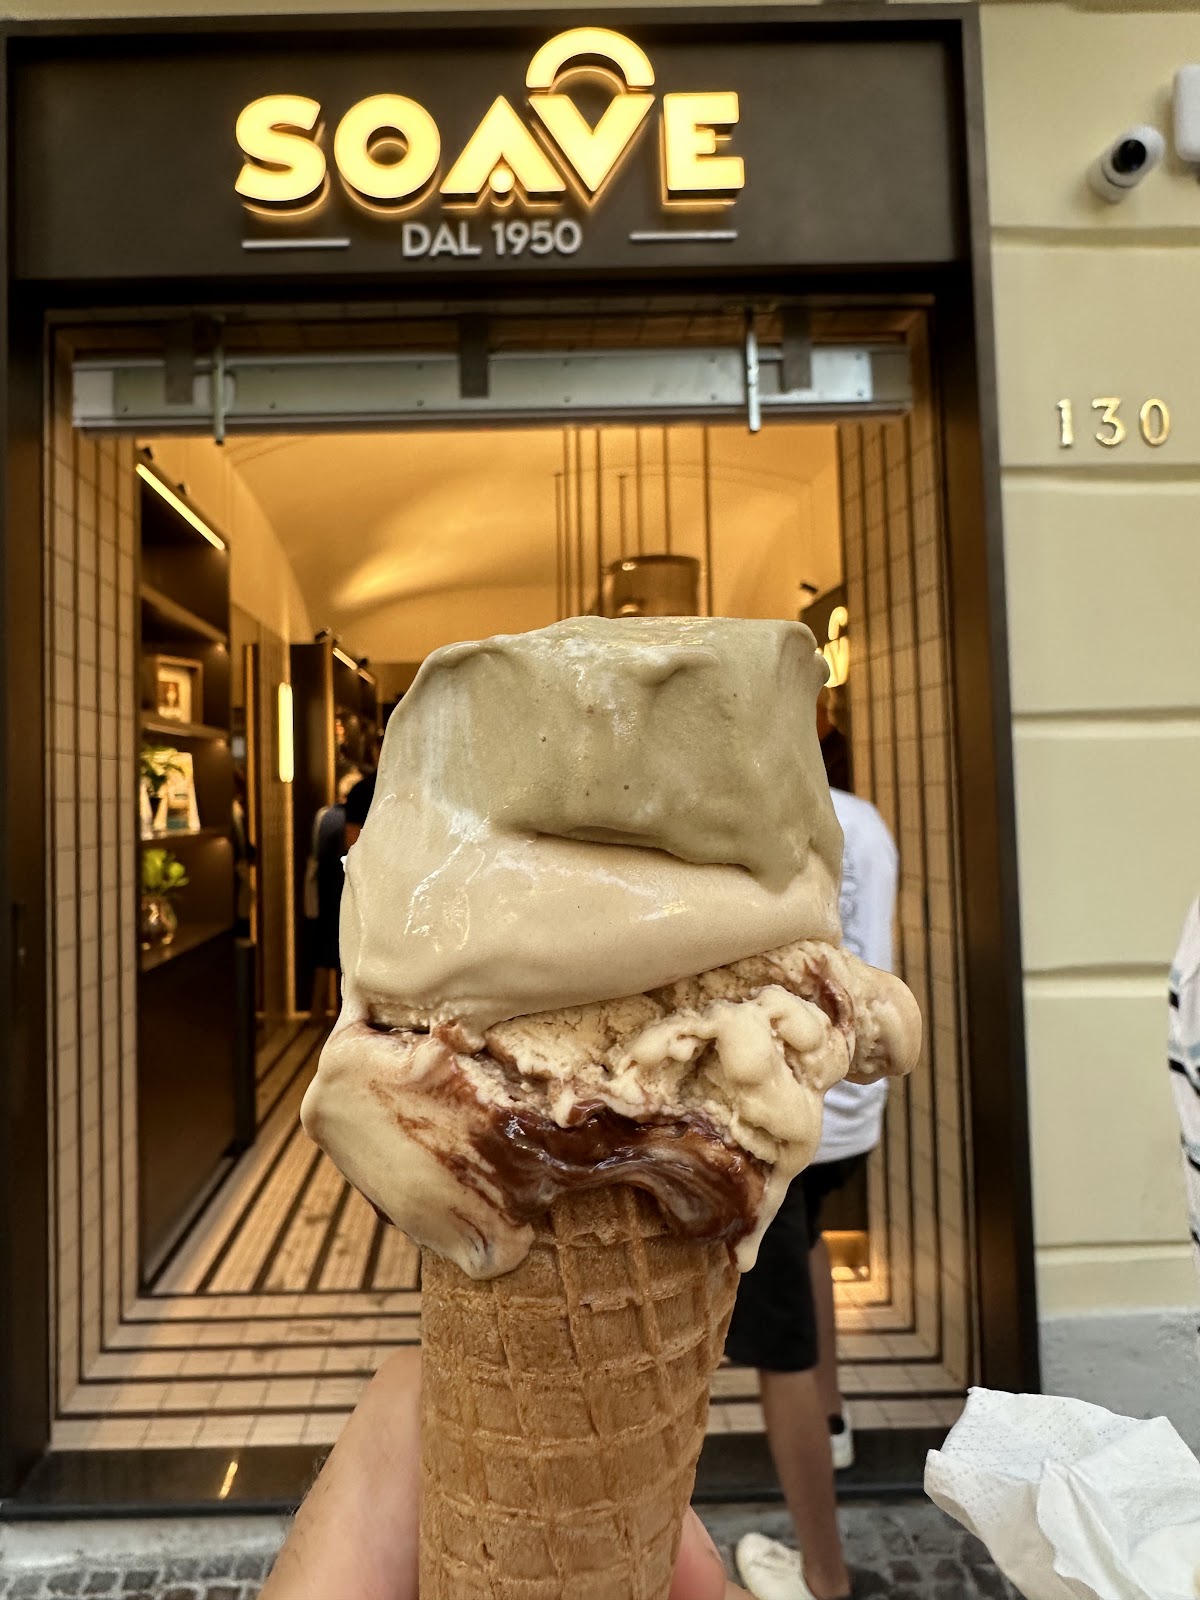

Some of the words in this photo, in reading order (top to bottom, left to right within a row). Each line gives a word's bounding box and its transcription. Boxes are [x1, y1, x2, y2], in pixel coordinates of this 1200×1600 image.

[235, 91, 745, 202] SOAVE
[402, 221, 482, 257] DAL
[491, 218, 582, 255] 1950
[1056, 397, 1170, 447] 130
